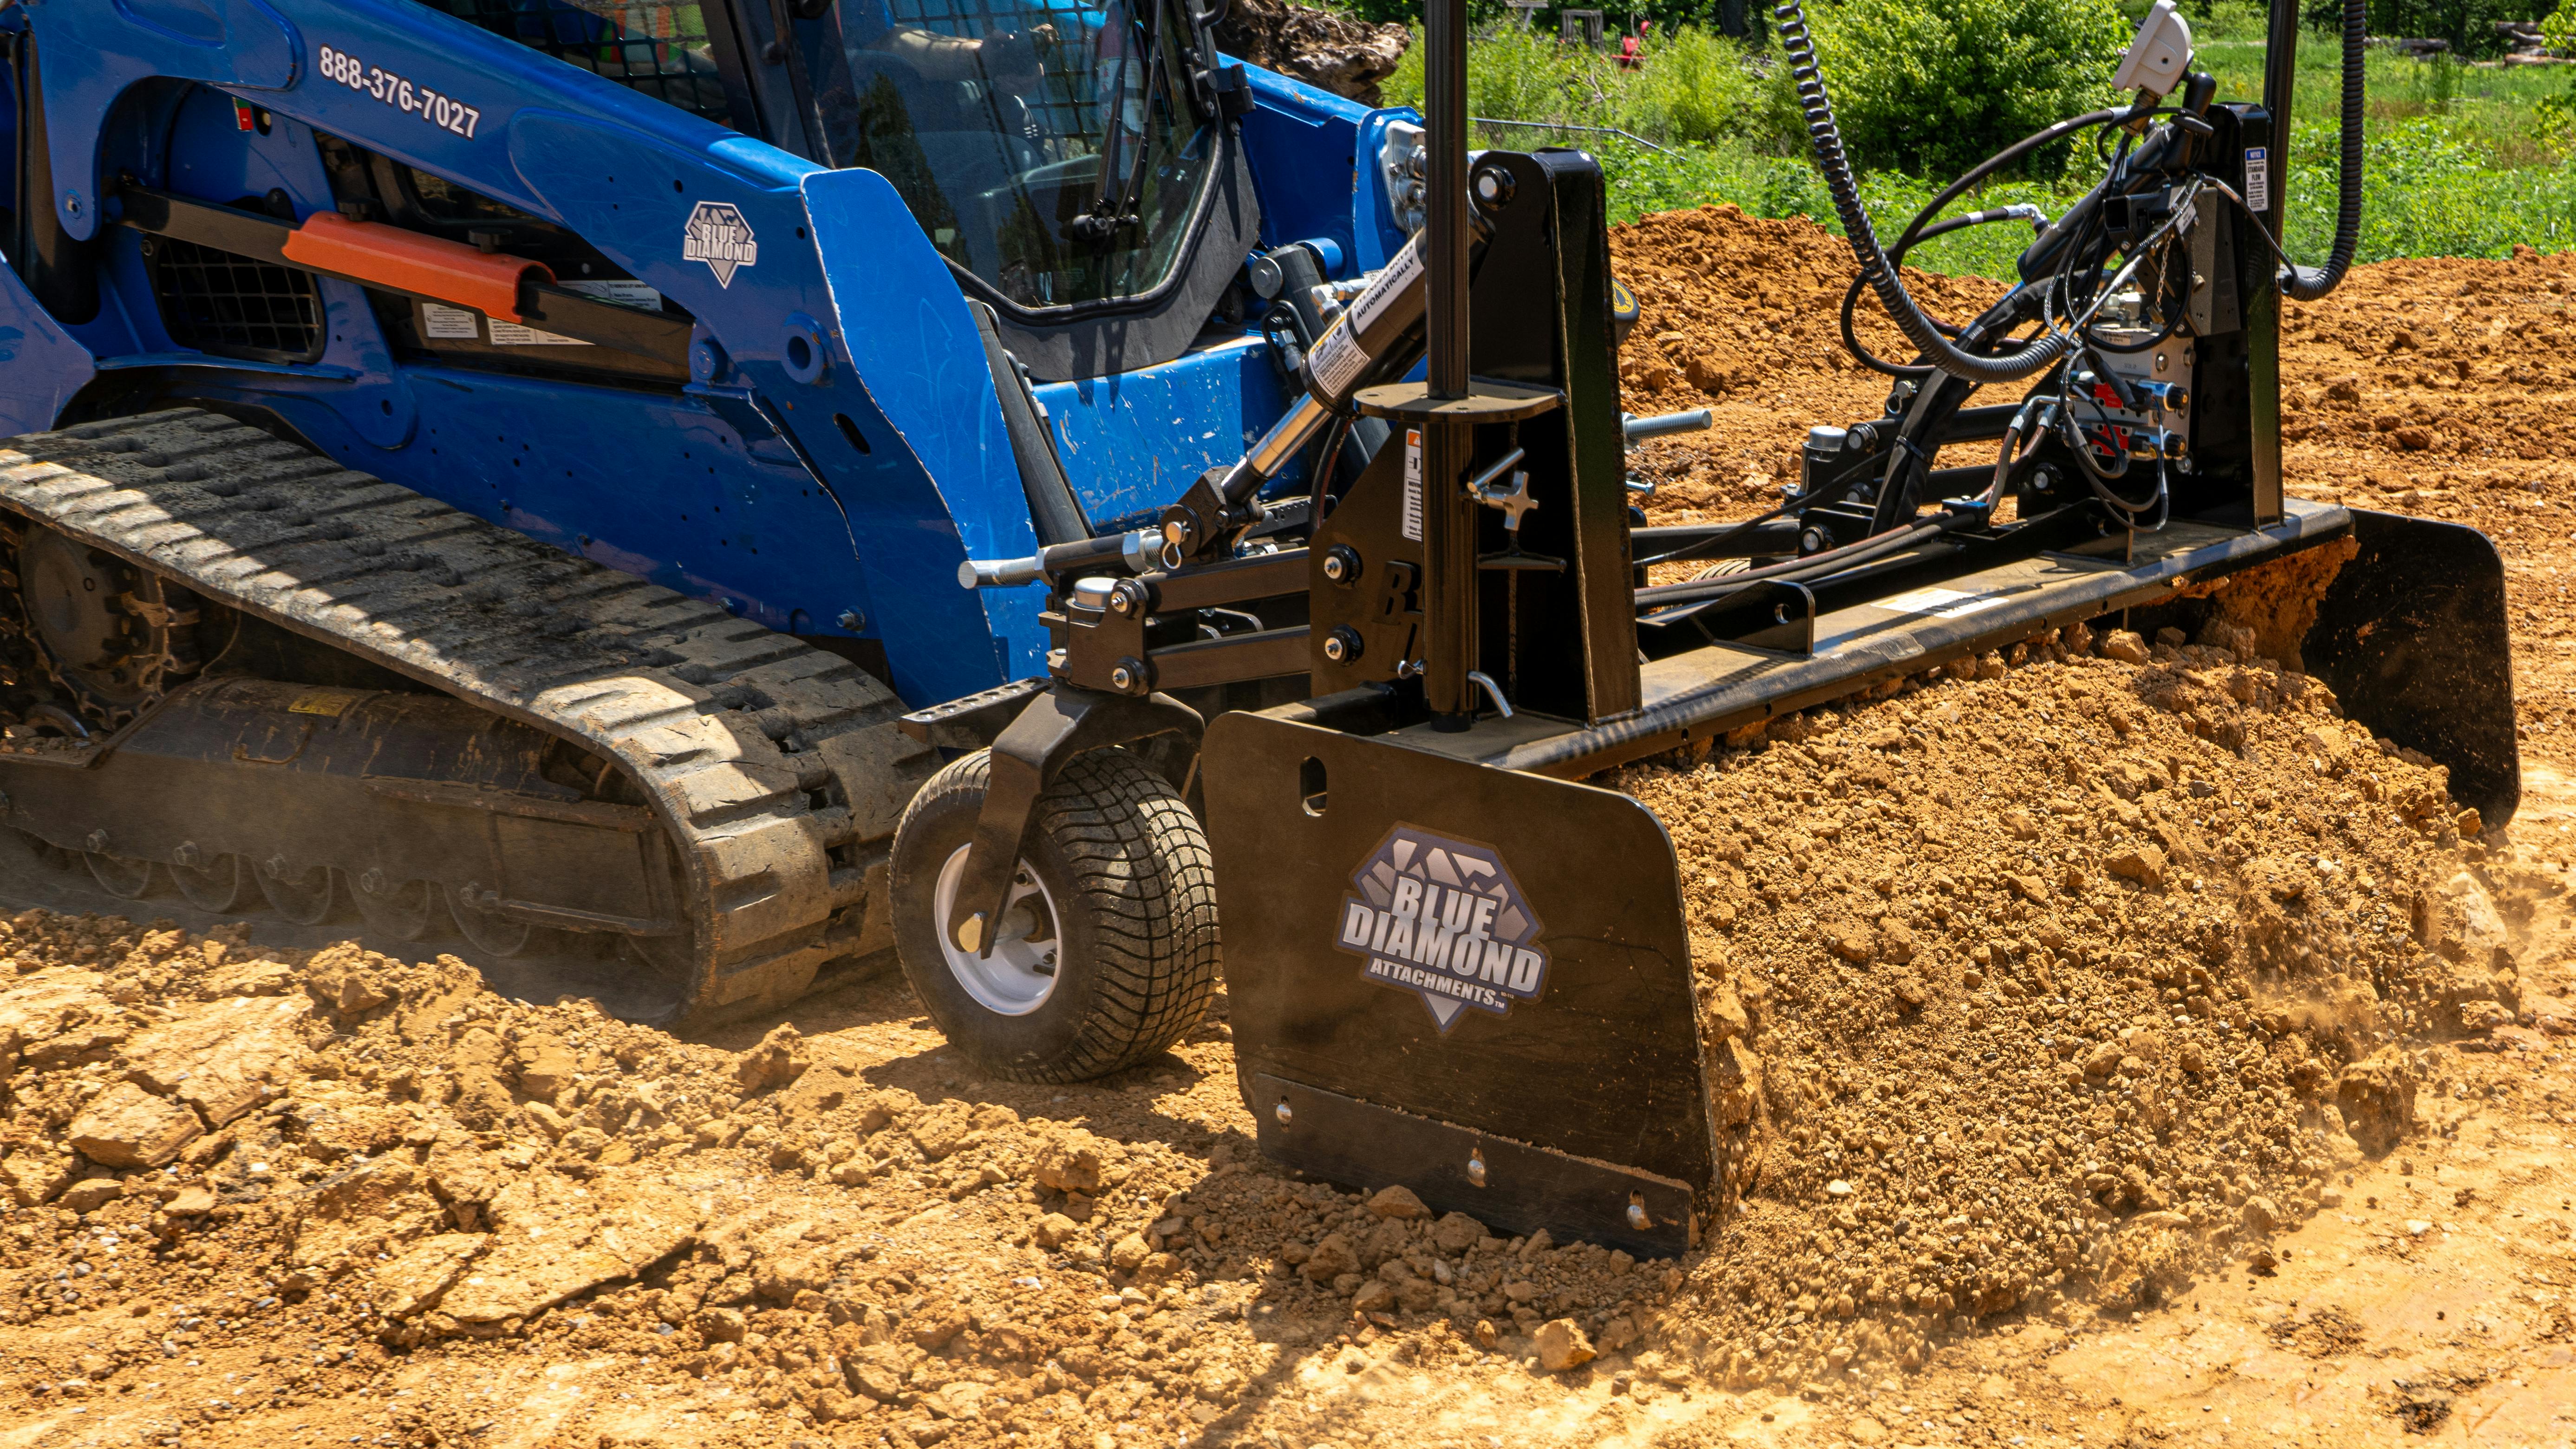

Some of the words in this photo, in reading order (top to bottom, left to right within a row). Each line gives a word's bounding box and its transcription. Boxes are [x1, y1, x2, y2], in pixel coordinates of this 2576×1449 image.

[320, 46, 480, 138] 888-376-7027
[686, 238, 754, 262] DIAMOND
[701, 223, 737, 243] BLUE
[1356, 256, 1414, 320] AUTOMATICALLY
[1392, 876, 1497, 941] BLUE
[1343, 903, 1542, 993] DIAMOND
[1370, 958, 1496, 1006] ATTACHMENTS
